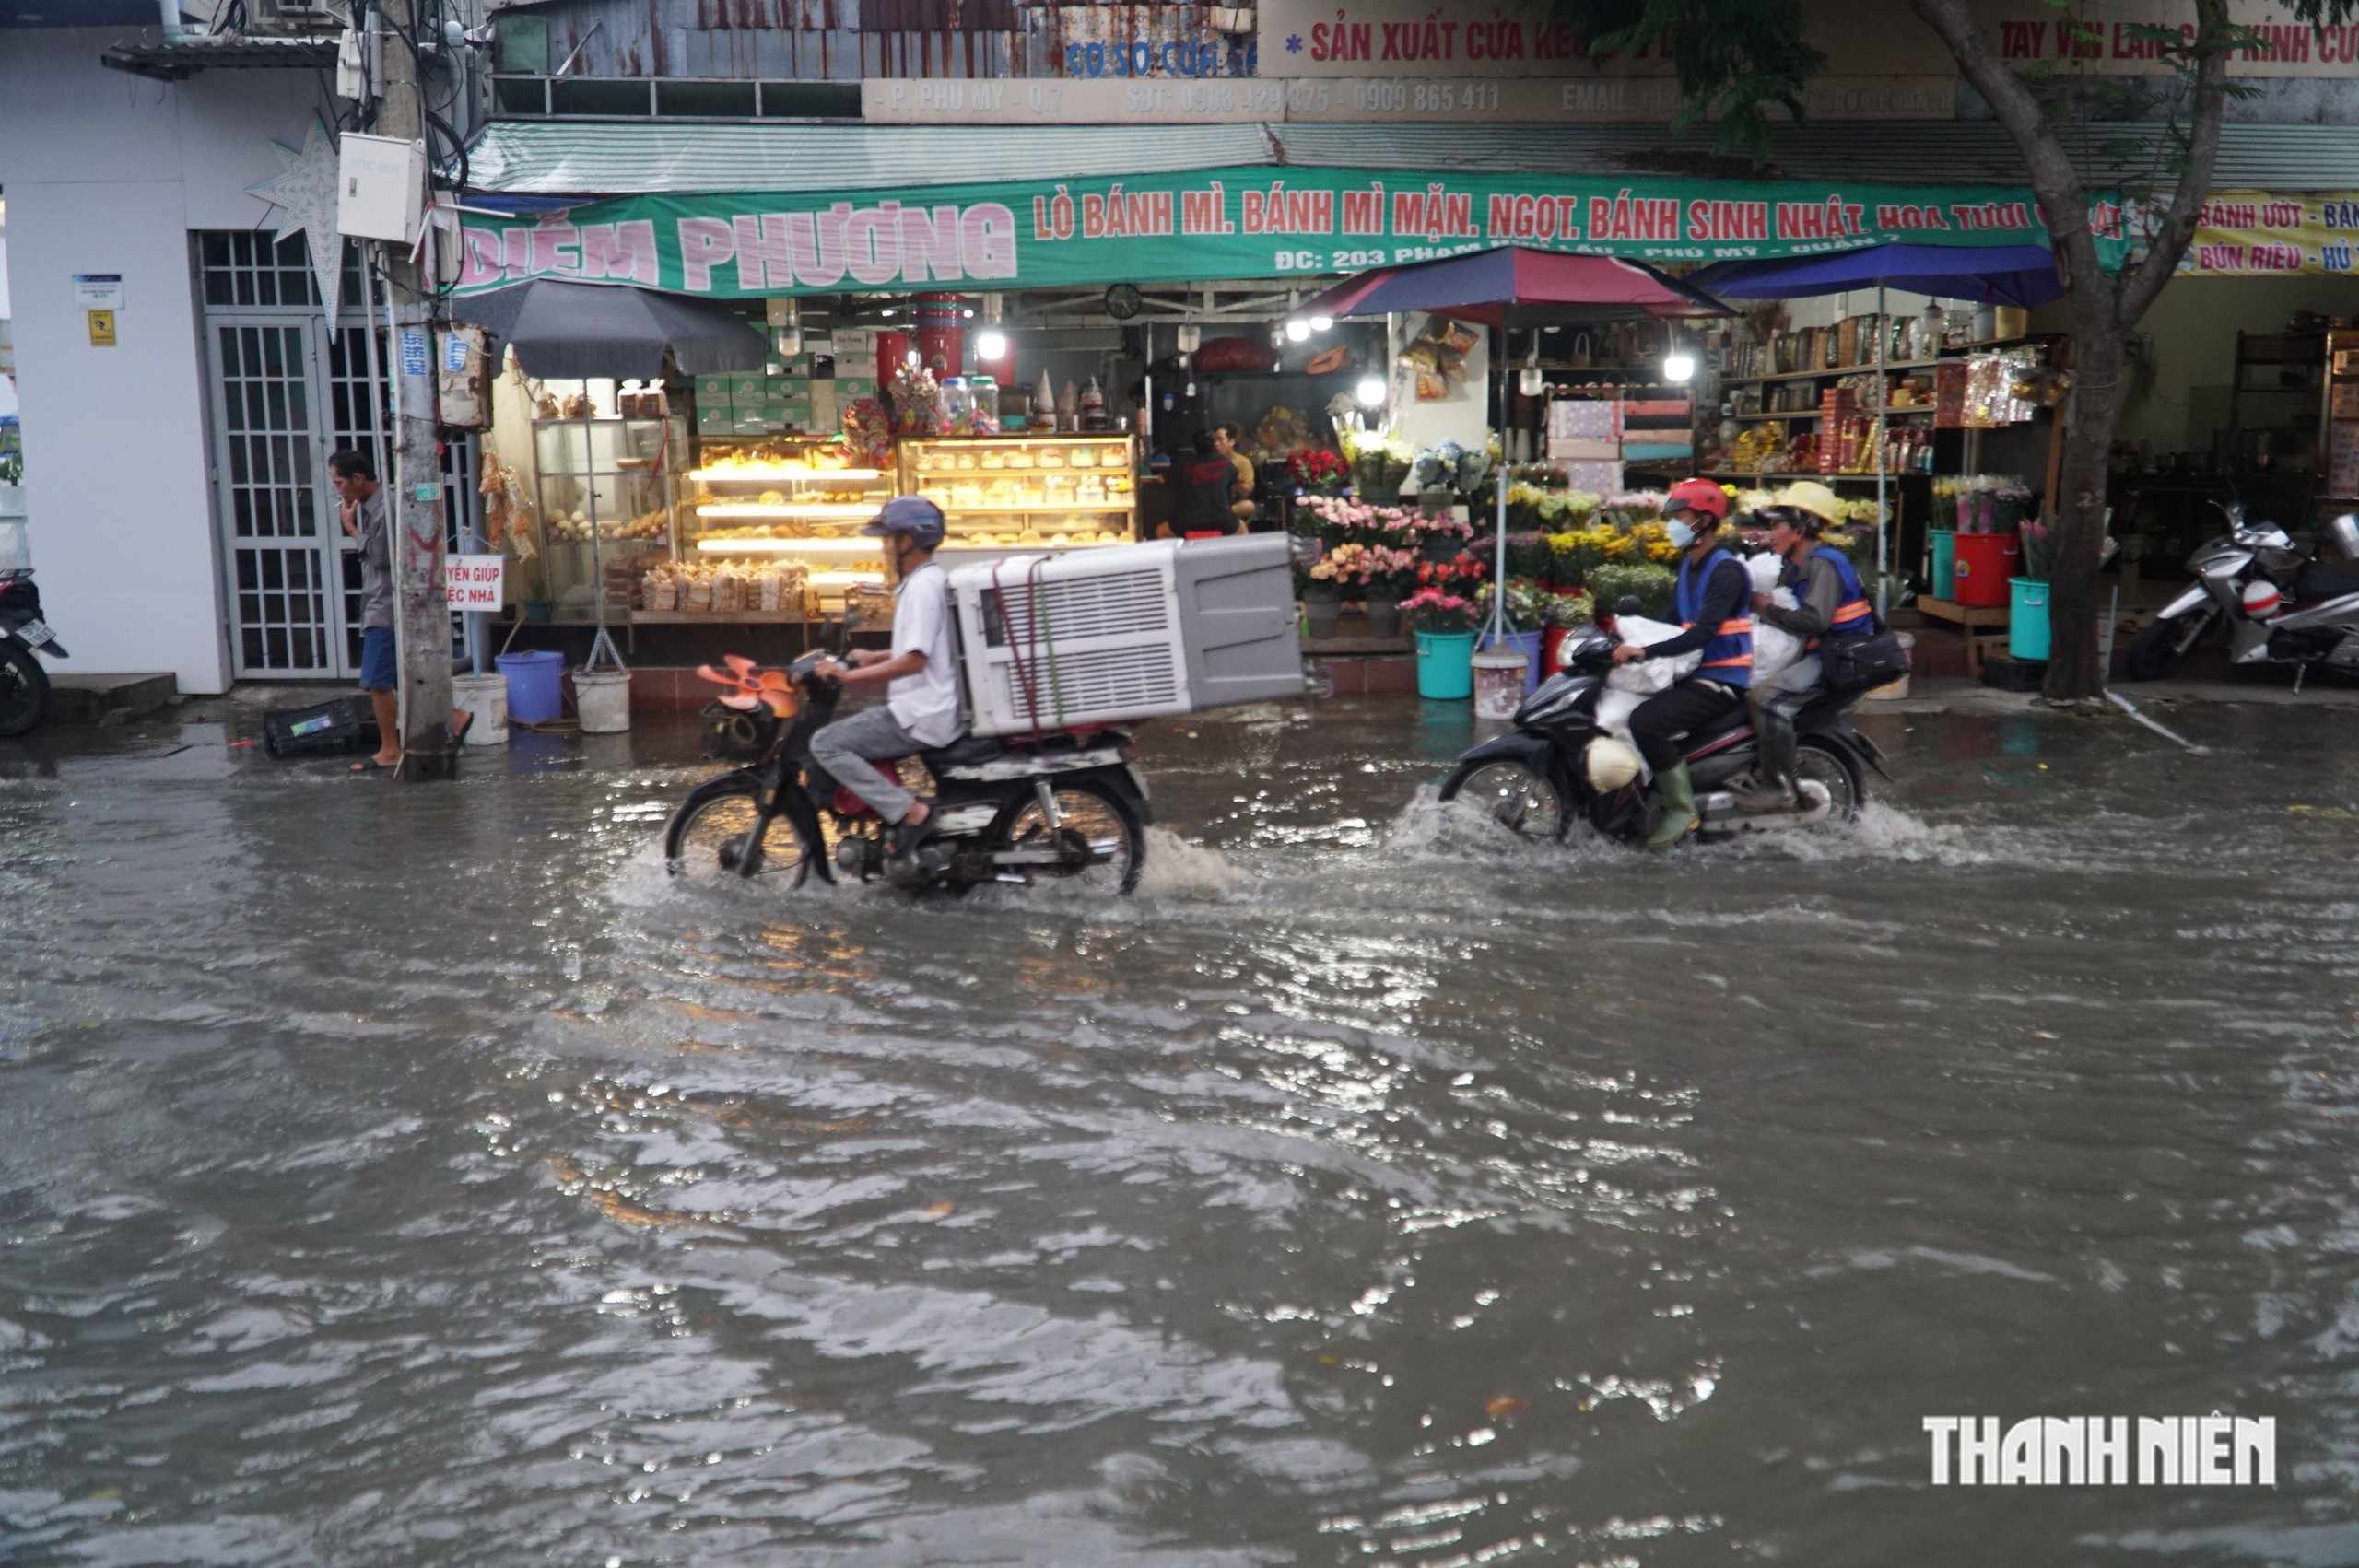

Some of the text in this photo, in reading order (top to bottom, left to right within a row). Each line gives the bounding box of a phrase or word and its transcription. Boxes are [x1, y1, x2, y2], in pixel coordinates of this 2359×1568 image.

[1310, 9, 1371, 61] SẢN
[1380, 7, 1458, 61] XUẤT
[1465, 7, 1526, 61] CỬA
[2000, 21, 2047, 58] TAY
[2242, 15, 2311, 63] KÍNH
[2318, 22, 2359, 64] CƯ
[1241, 83, 1284, 112] 429
[1353, 83, 1407, 112] 0909
[1414, 83, 1455, 111] 865
[1461, 83, 1500, 111] 411
[1033, 183, 1074, 240] LÒ
[1082, 182, 1173, 238] BÁNH
[1182, 181, 1235, 236] MÌ.
[1243, 181, 1334, 235] BÁNH
[1342, 181, 1384, 236] MÌ
[1392, 183, 1479, 243] MẶN.
[1488, 193, 1579, 244] NGỌT.
[1589, 188, 1681, 241] BÁNH
[1688, 197, 1769, 242] SINH
[1876, 204, 1951, 231] HOA
[2200, 197, 2256, 228] BÁNH
[678, 199, 1018, 291] PHƯƠNG
[1274, 250, 1324, 270] ĐC:
[1332, 249, 1385, 268] 203
[2199, 240, 2244, 271] BÚN
[2249, 240, 2302, 271] RIÊU
[446, 558, 500, 582] YỂN GIÚP
[446, 585, 496, 606] ỆC NHÀ
